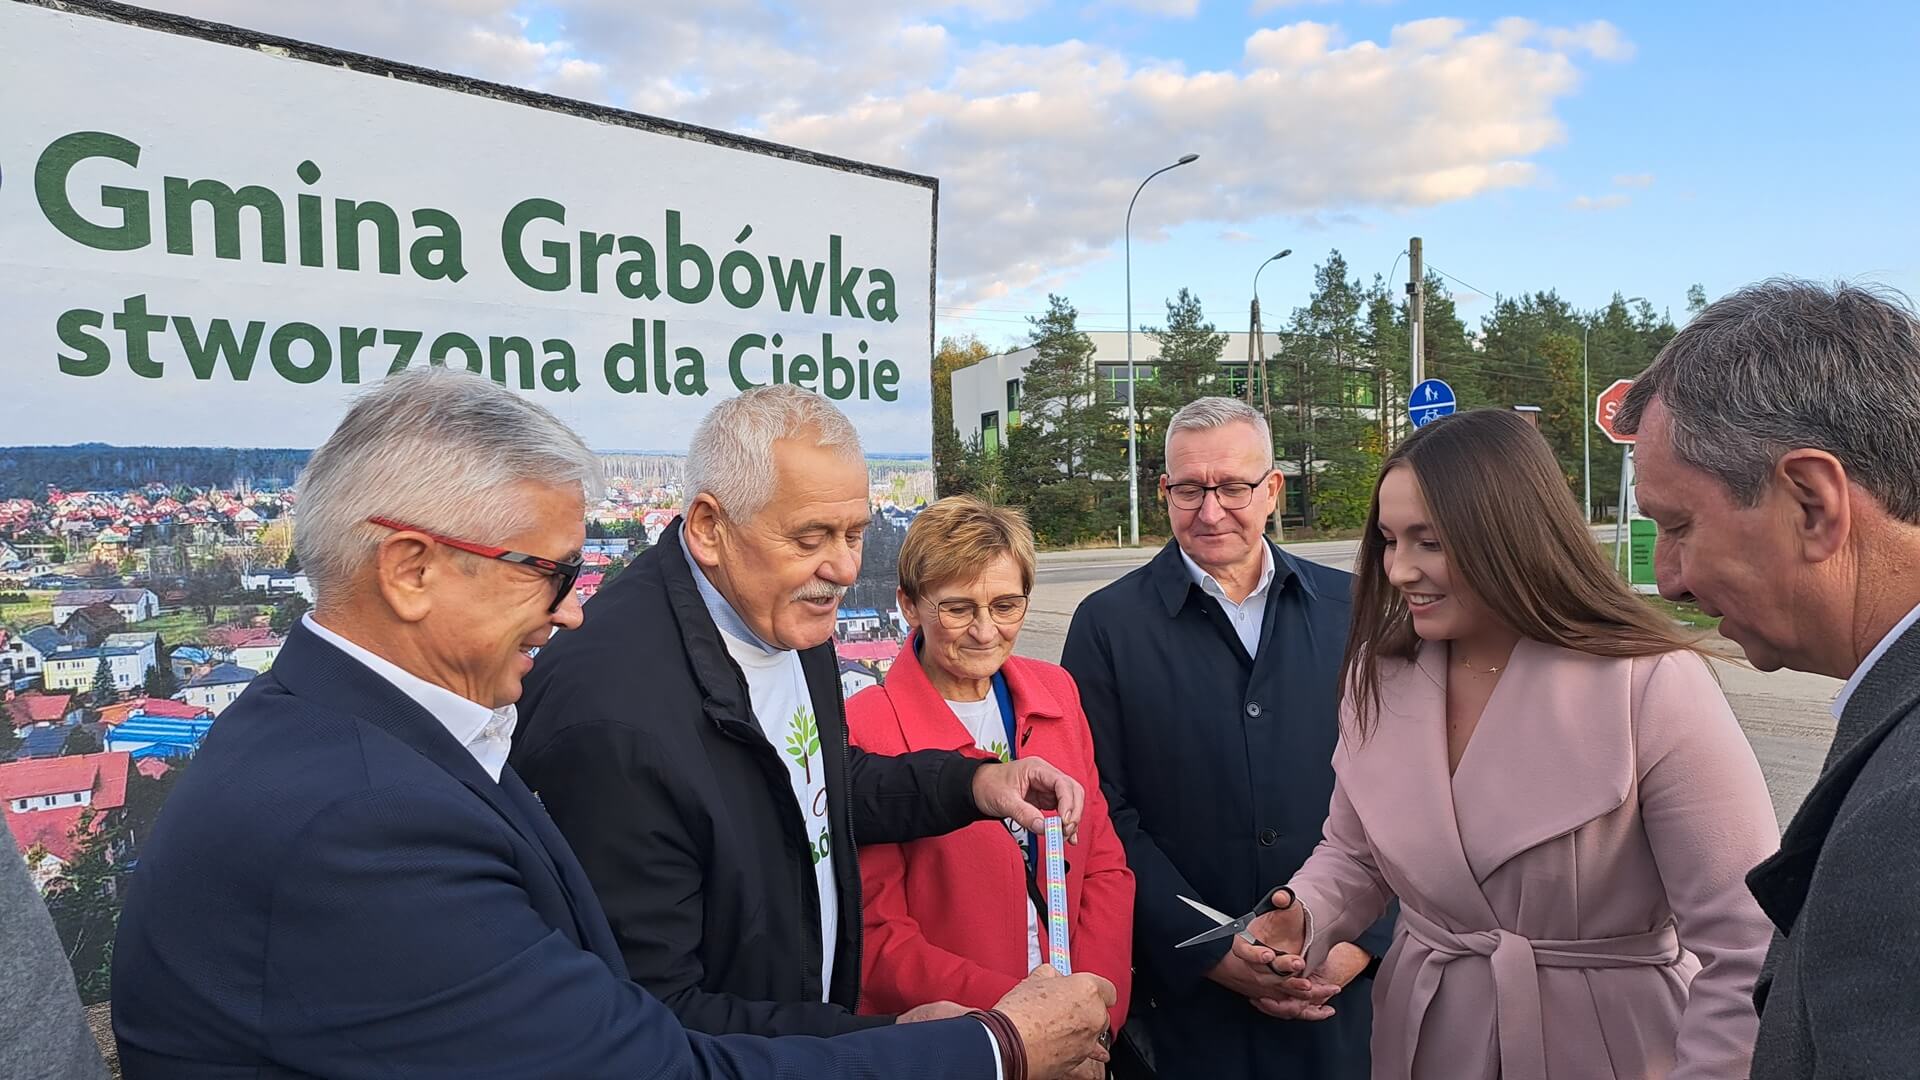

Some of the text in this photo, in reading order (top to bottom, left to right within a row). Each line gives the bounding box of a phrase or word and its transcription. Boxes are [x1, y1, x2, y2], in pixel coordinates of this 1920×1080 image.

[34, 131, 898, 323] Gmina Grabówka
[56, 293, 900, 402] stworzona dla Ciebie
